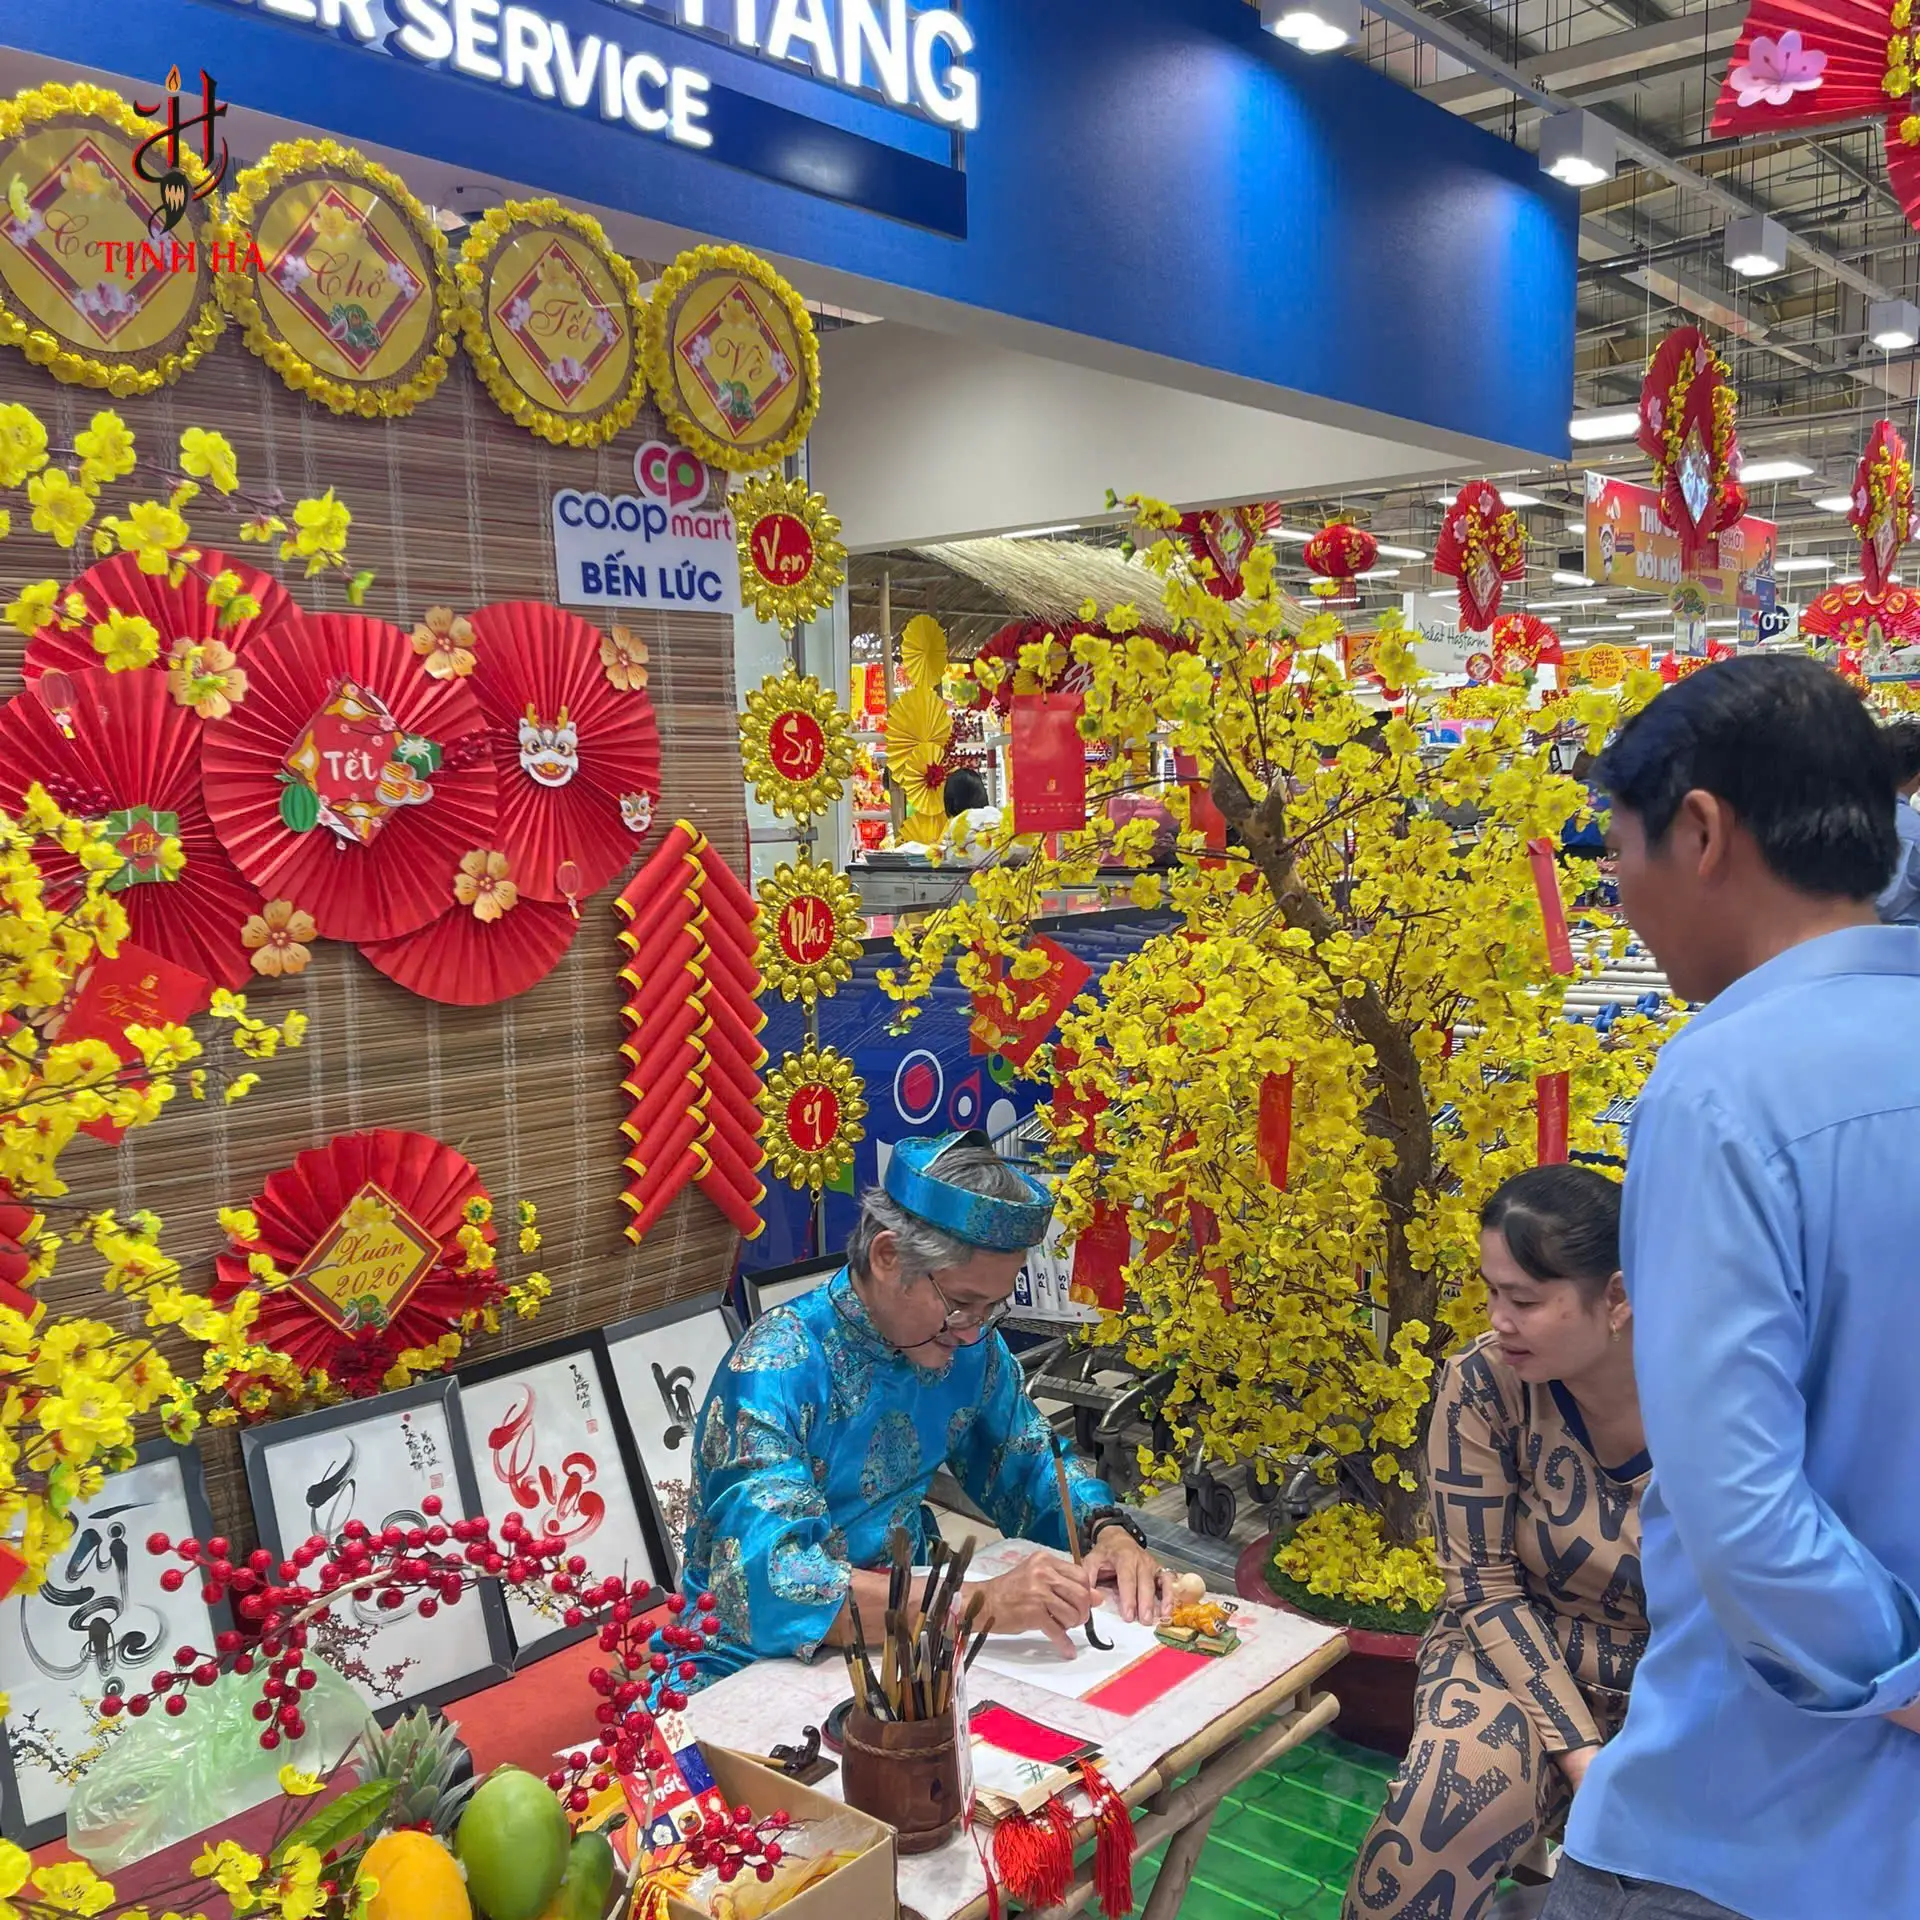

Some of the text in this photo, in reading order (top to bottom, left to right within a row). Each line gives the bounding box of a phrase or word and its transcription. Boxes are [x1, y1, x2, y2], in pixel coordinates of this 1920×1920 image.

[398, 0, 714, 148] SERVICE
[529, 299, 592, 342] Tết
[760, 522, 805, 577] Vạn
[581, 550, 723, 602] BẾN LỨC
[322, 748, 378, 781] Tết
[334, 1233, 406, 1268] Xuân
[332, 1262, 406, 1299] 2026
